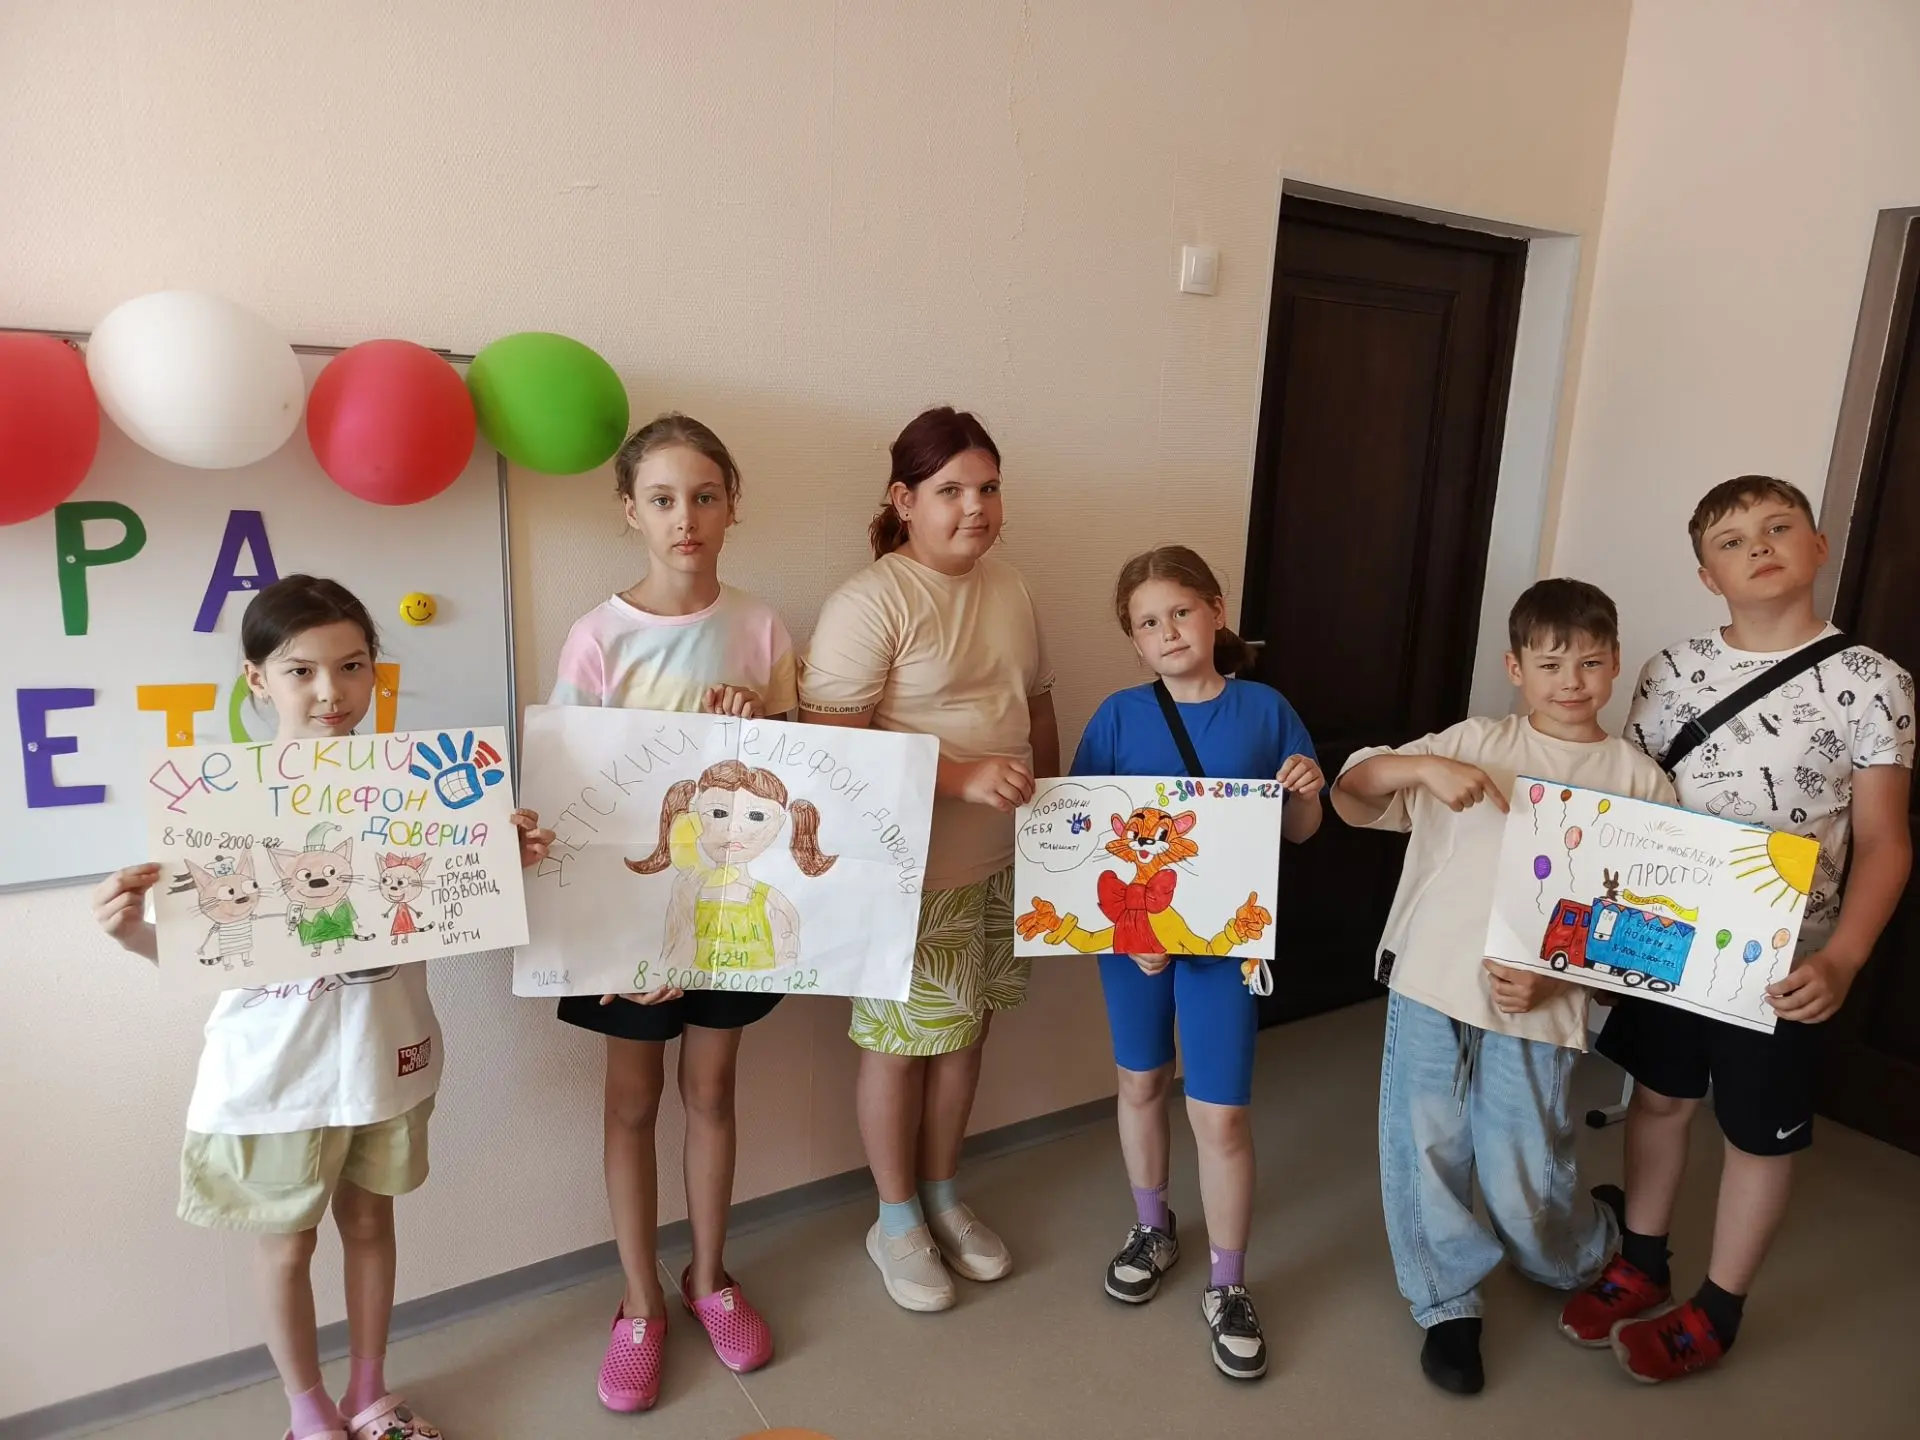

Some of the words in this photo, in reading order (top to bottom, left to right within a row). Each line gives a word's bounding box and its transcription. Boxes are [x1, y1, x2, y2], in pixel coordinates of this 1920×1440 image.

[1811, 728, 1846, 758] SUPER
[1692, 771, 1714, 779] LAZY
[1718, 770, 1743, 778] DAYS
[1032, 799, 1090, 818] ПОЗВОНИ!
[1024, 822, 1053, 836] ТЕБЯ
[1626, 862, 1713, 887] ПРОСТО!
[444, 902, 463, 920] НО
[442, 928, 481, 945] ШУТИ
